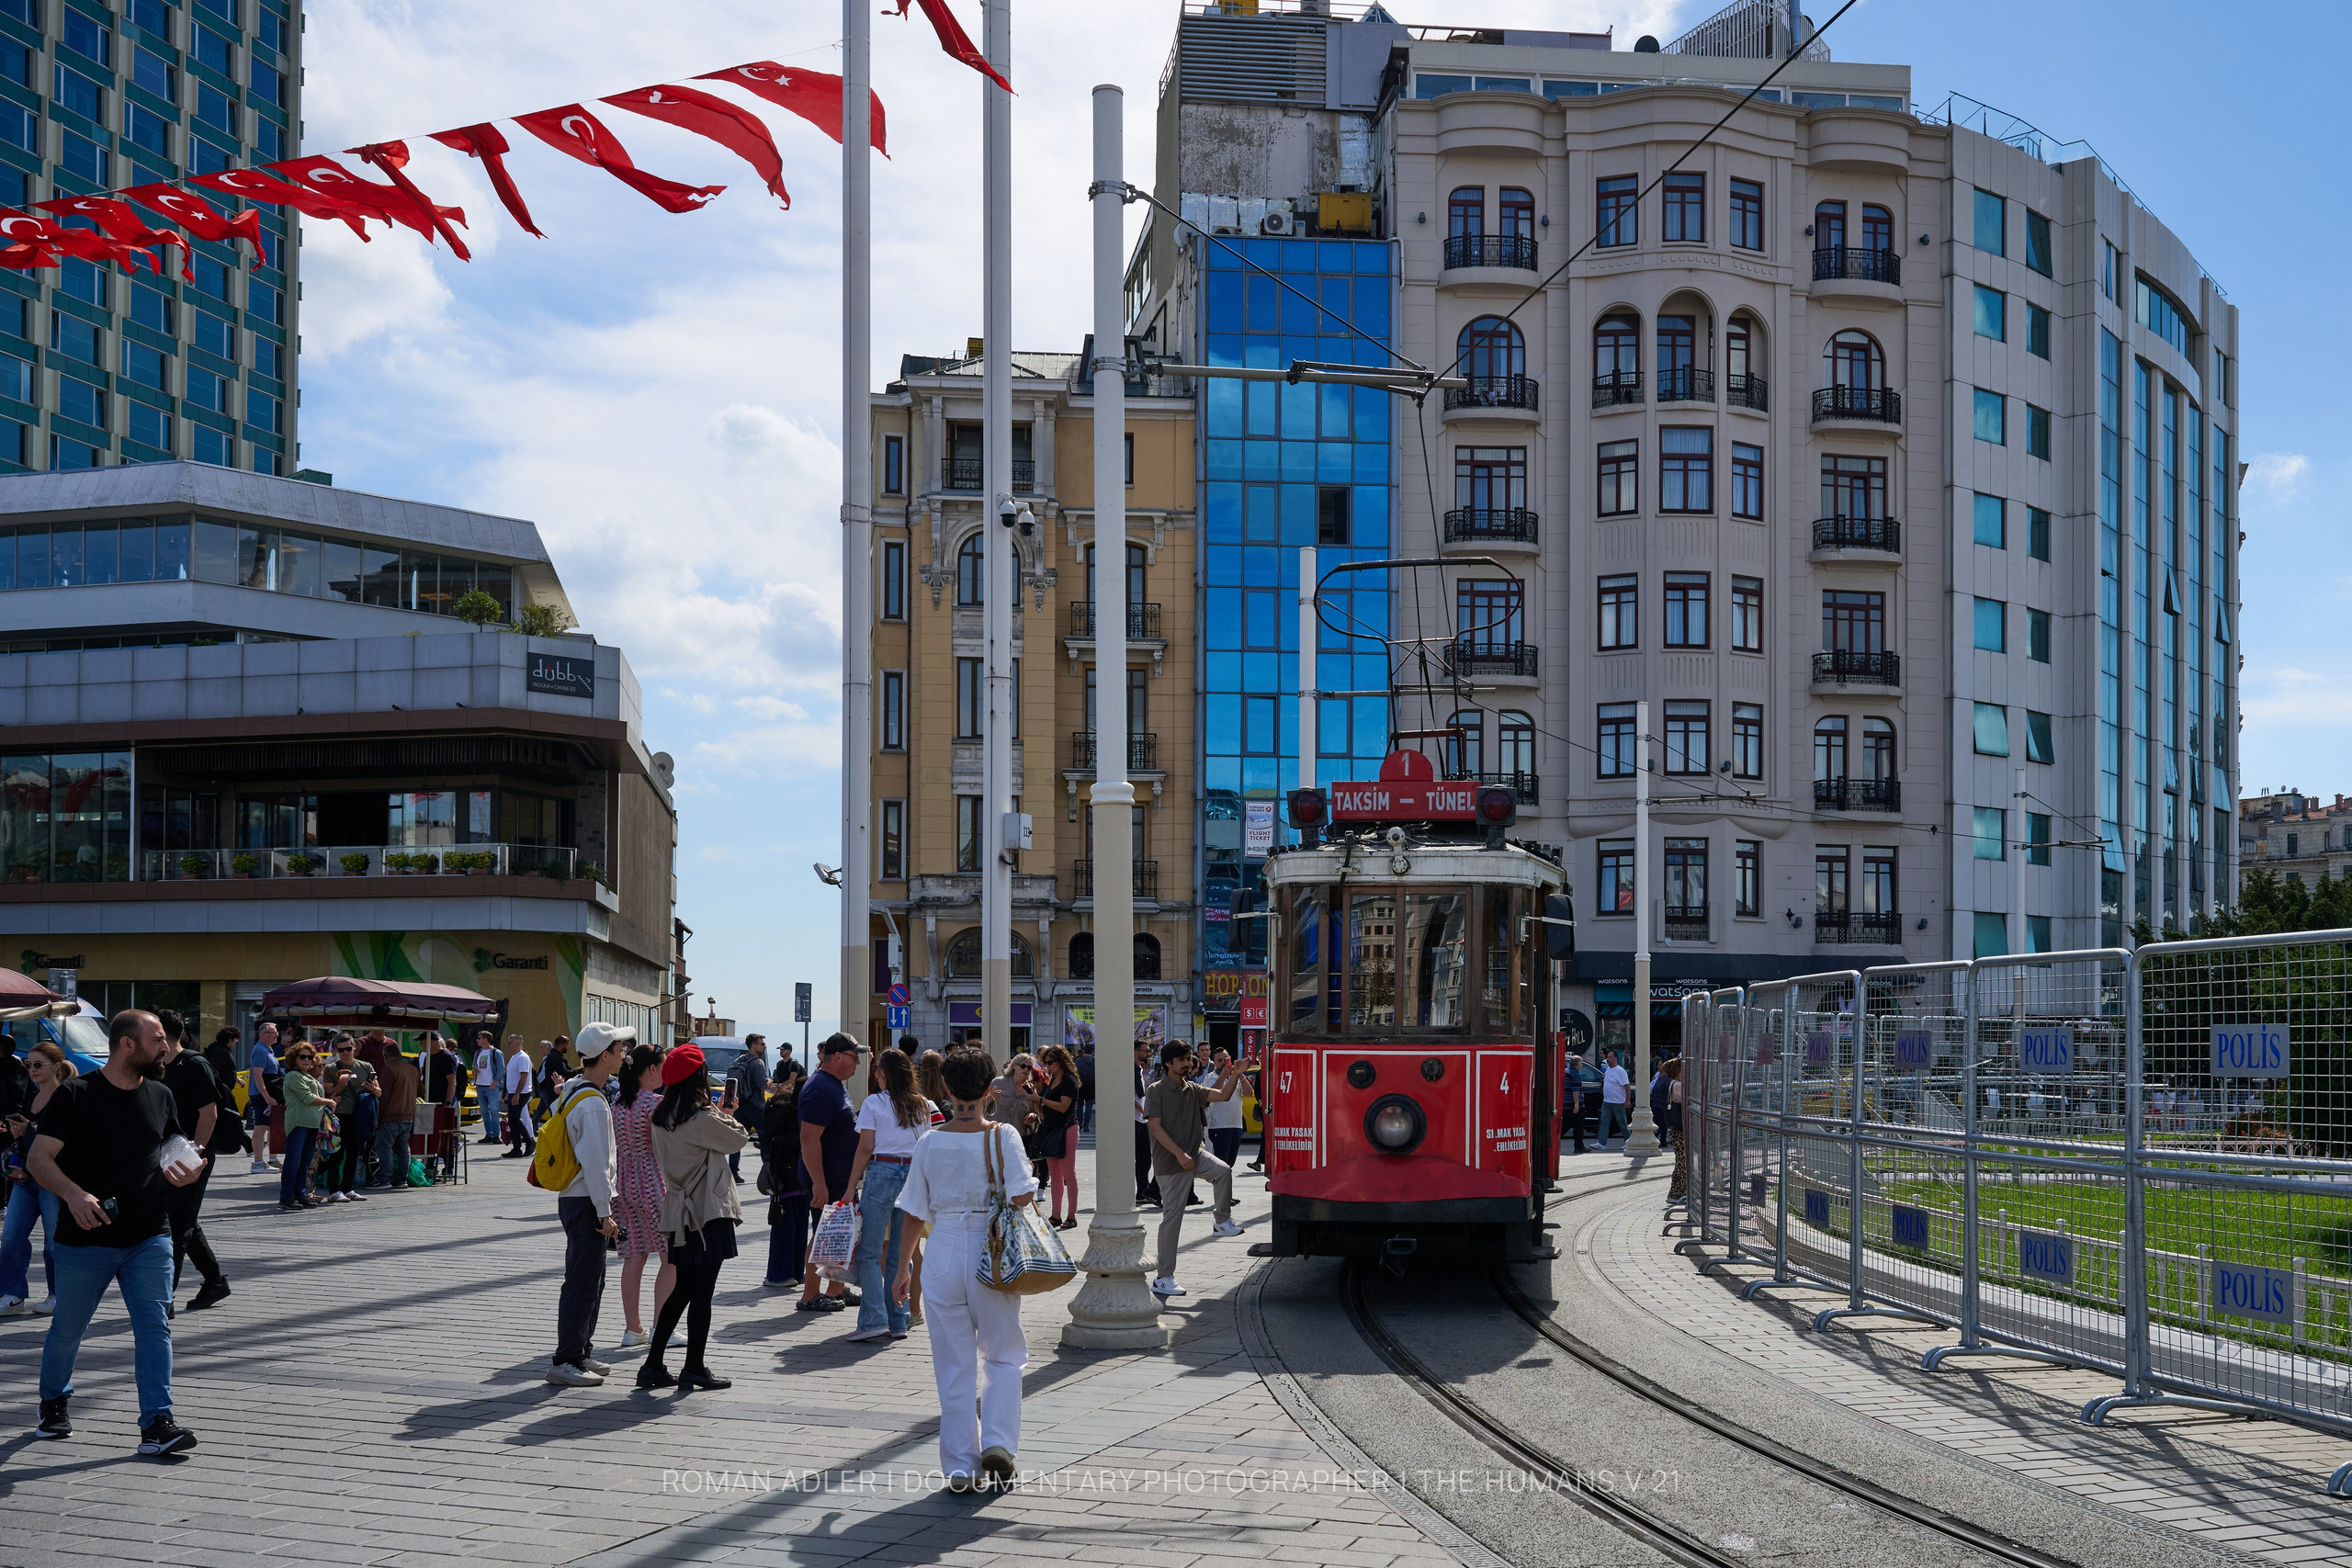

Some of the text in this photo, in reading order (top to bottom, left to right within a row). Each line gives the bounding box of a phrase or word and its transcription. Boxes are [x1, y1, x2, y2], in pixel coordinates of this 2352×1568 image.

[1402, 752, 1408, 776] 1
[1335, 786, 1389, 811] TAKSİM
[1426, 787, 1475, 811] TÜNEL
[36, 953, 84, 968] Garanti
[493, 953, 548, 969] Garanti
[1898, 1031, 1927, 1063] POLİS
[2025, 1028, 2066, 1066] POLİS
[2217, 1024, 2281, 1068] POLİS
[1280, 1072, 1292, 1093] 47
[1500, 1072, 1509, 1094] 4
[1291, 1127, 1313, 1137] YASAK
[1807, 1192, 1827, 1222] POLİS
[1895, 1211, 1926, 1244] POLİS
[2025, 1236, 2066, 1275] POLİS
[2220, 1268, 2284, 1314] POLİS
